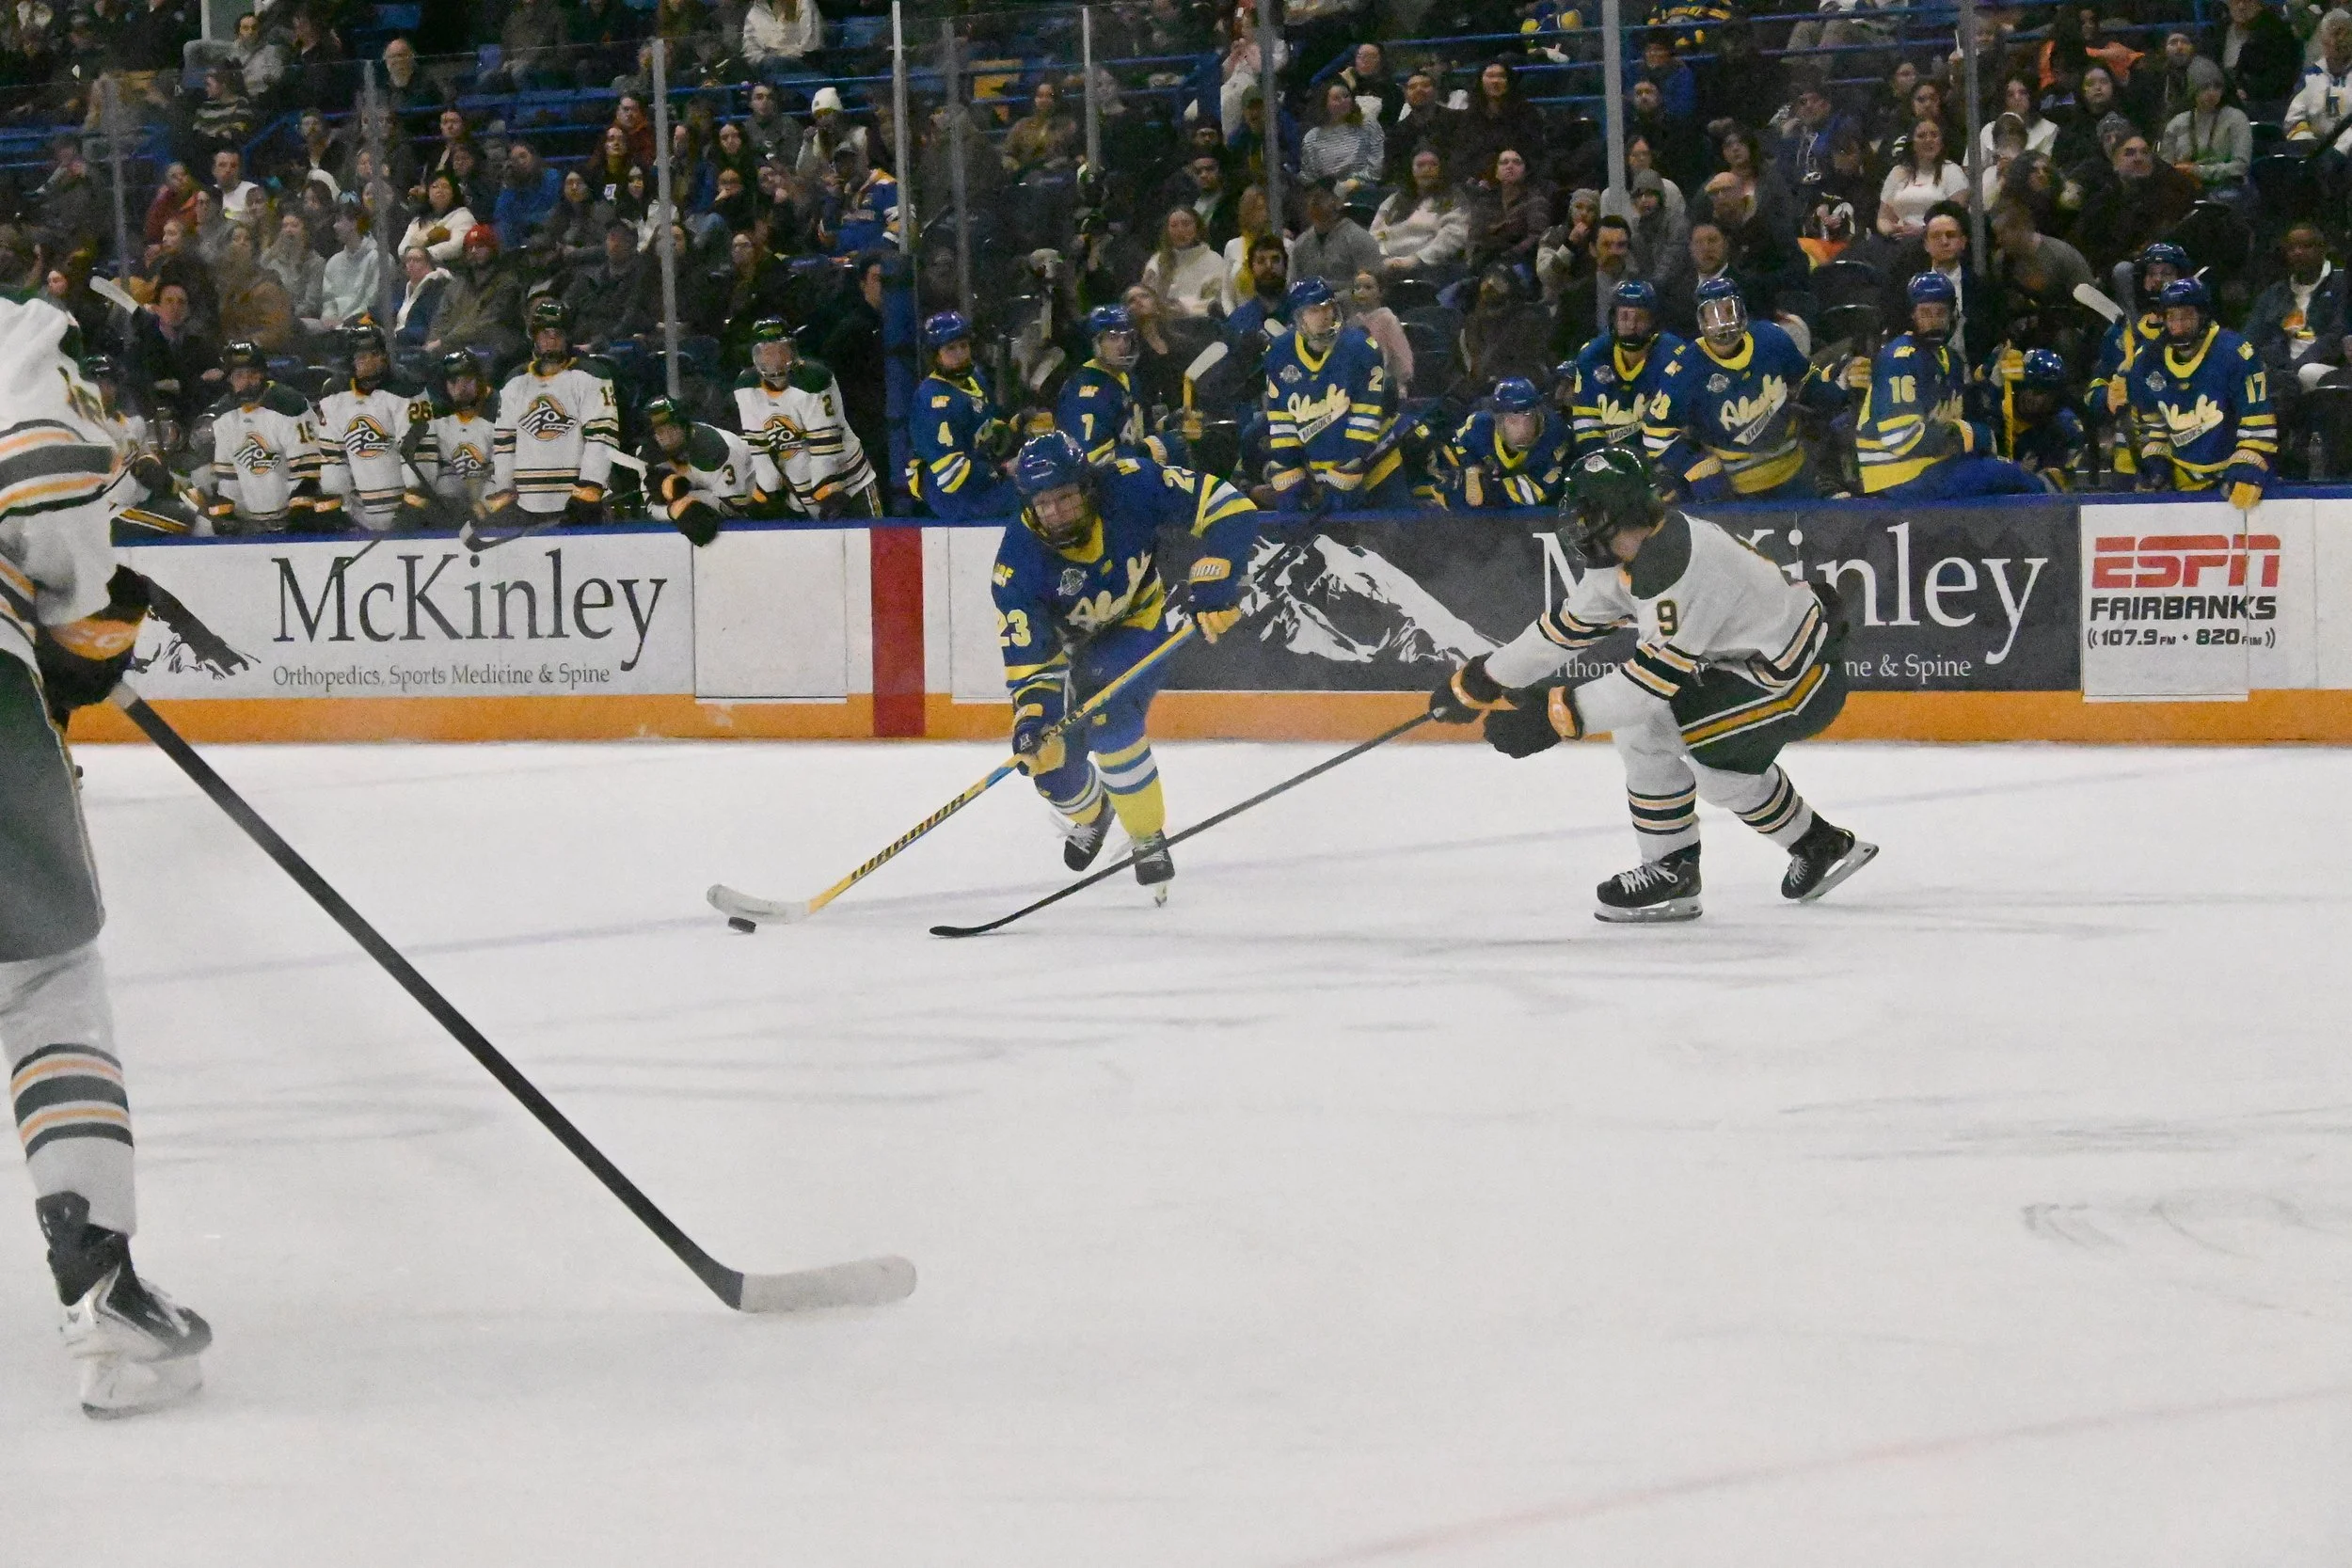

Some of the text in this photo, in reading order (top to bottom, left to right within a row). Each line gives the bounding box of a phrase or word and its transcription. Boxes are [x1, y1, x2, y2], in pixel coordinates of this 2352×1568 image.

[1369, 366, 1384, 391] 2
[1888, 375, 1916, 404] 16
[2246, 372, 2266, 403] 17
[821, 394, 835, 418] 2
[937, 421, 954, 447] 4
[1081, 414, 1094, 441] 7
[723, 464, 736, 485] 3
[2091, 533, 2281, 589] ESPN
[271, 547, 668, 672] McKinley
[1656, 599, 1678, 636] 9
[2090, 595, 2277, 621] FAIRBANKS
[997, 610, 1032, 647] 23
[2102, 628, 2158, 646] 107.9
[2195, 627, 2240, 645] 820
[273, 662, 611, 693] Orthopedics, Sports Medicine & Spine
[1904, 653, 1972, 685] Spine
